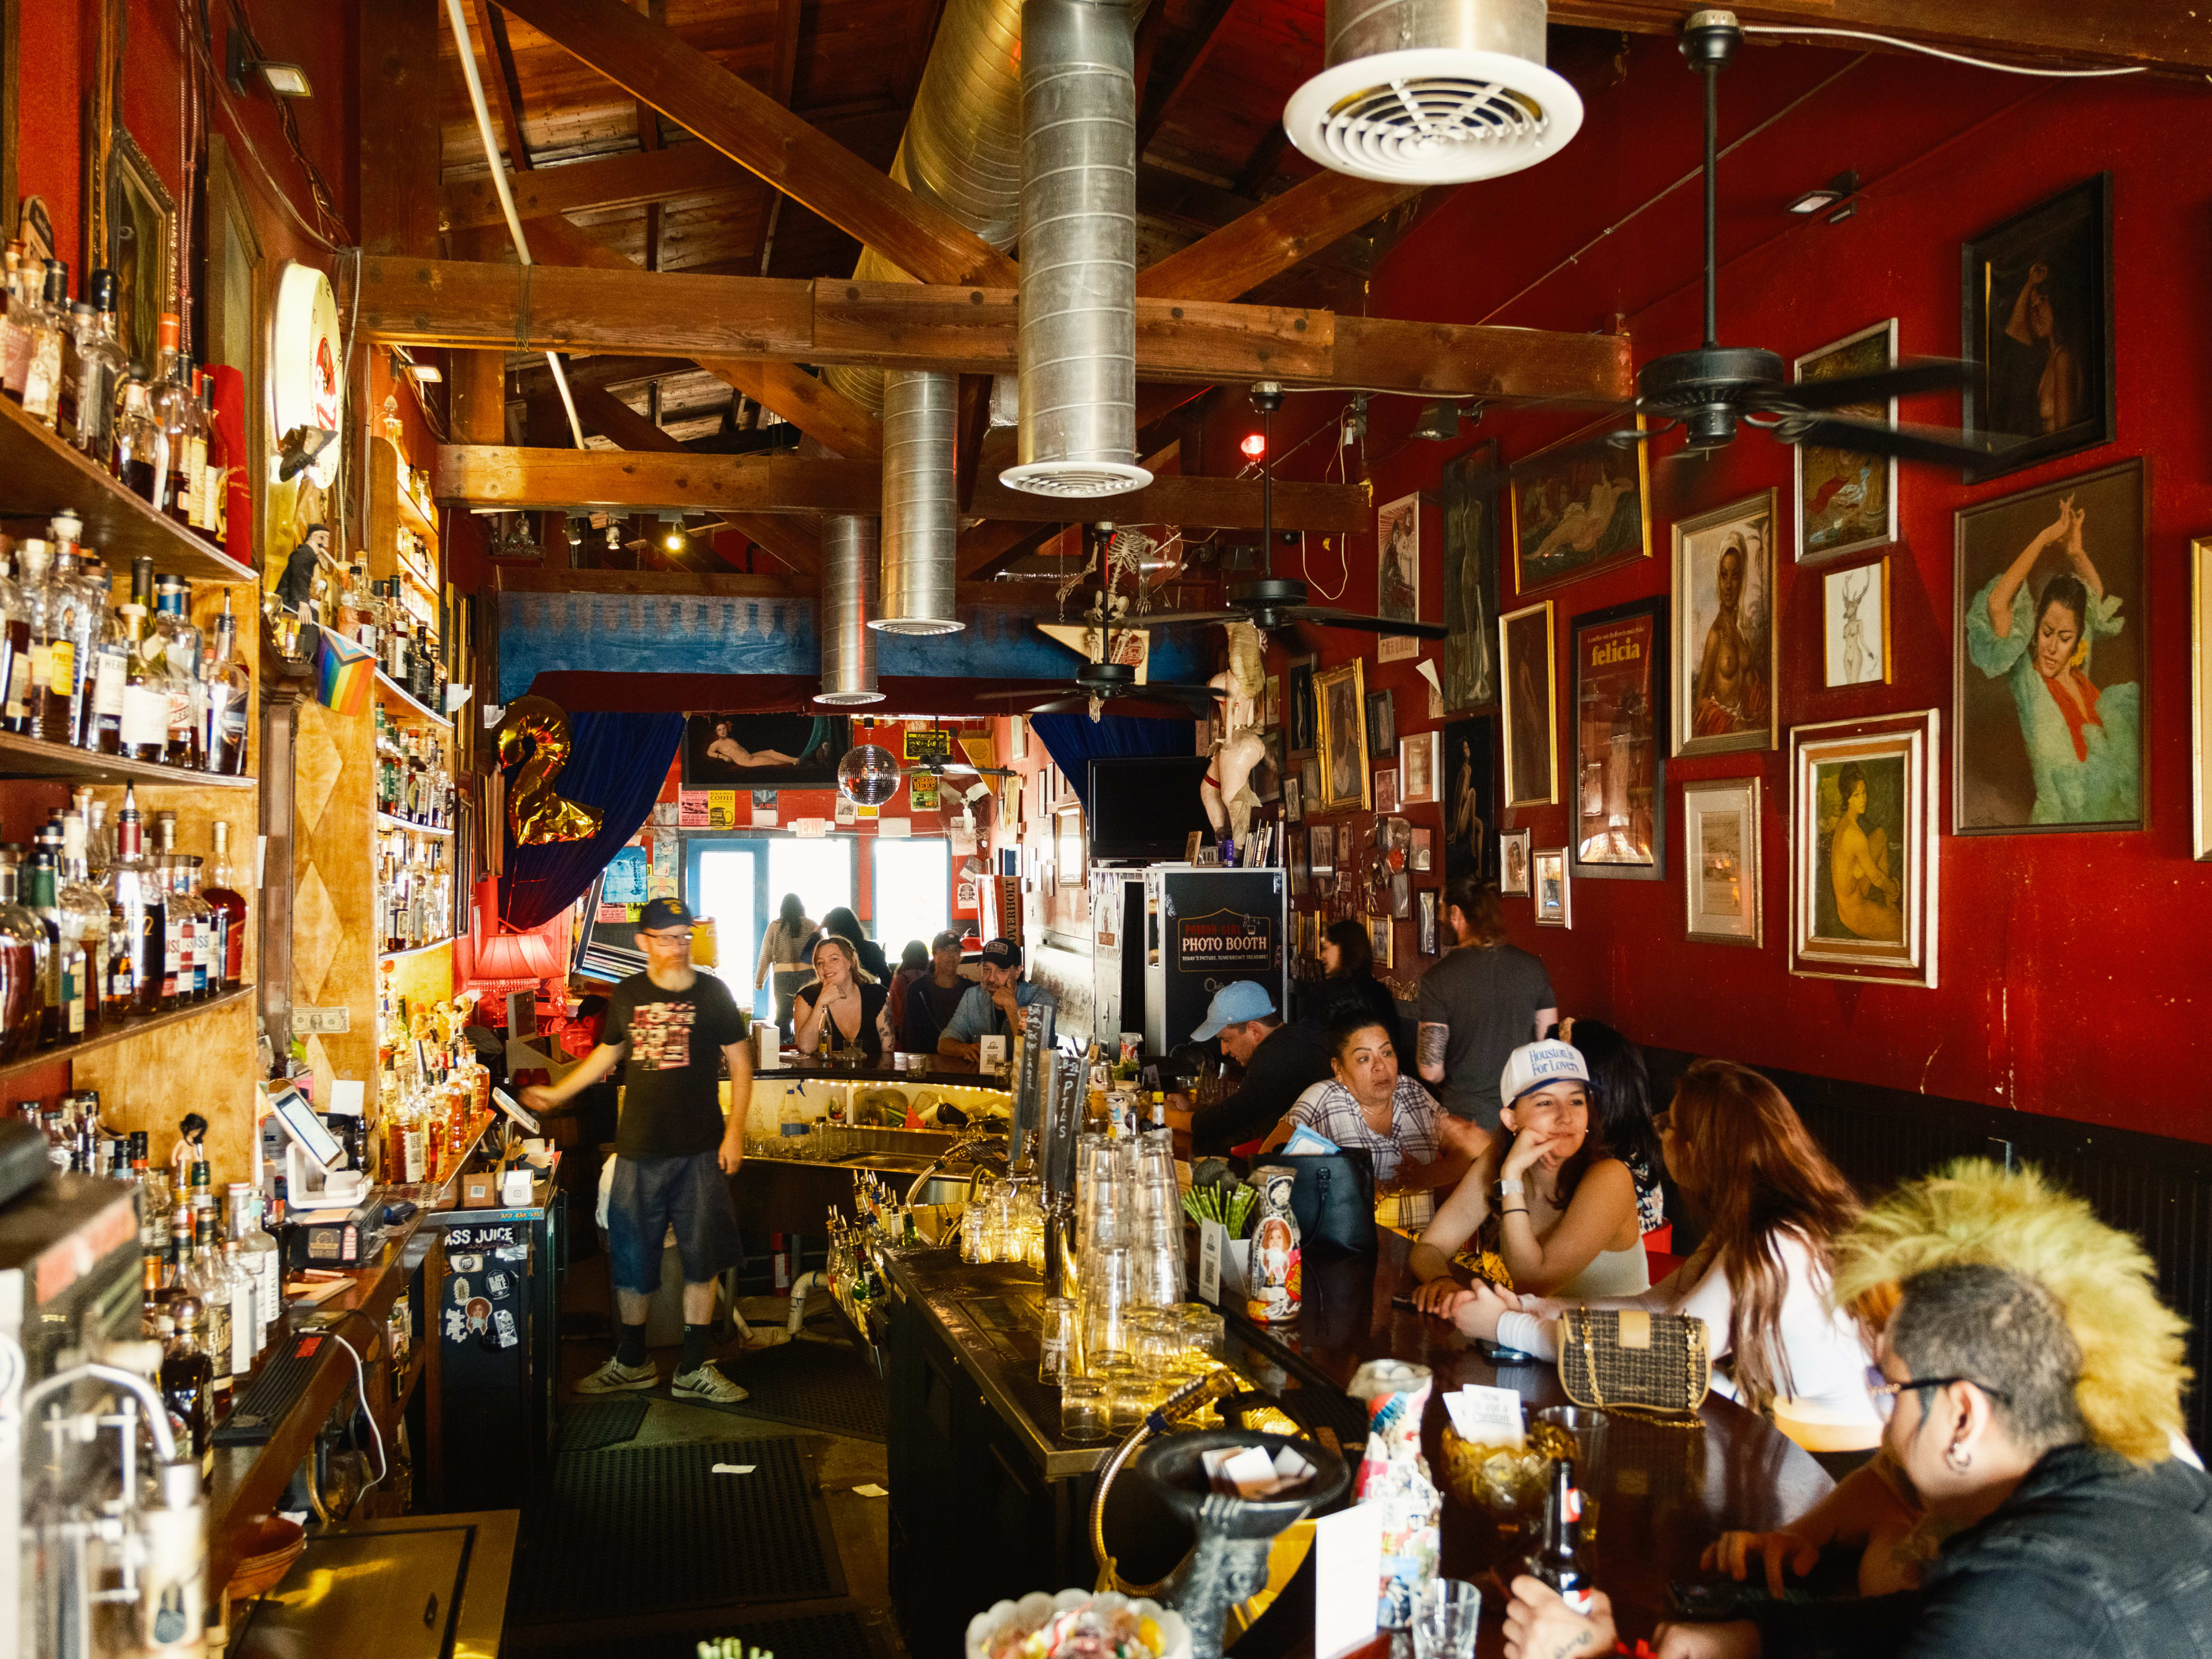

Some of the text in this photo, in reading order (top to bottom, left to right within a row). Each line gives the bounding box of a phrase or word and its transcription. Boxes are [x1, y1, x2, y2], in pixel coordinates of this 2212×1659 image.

[1592, 637, 1641, 666] felicia
[801, 819, 821, 834] EXIT
[1006, 880, 1016, 942] OVERHOLT
[1185, 923, 1241, 935] POISON GIRL
[1182, 935, 1267, 952] PHOTO BOOTH
[1529, 1047, 1575, 1063] Houston's
[1532, 1062, 1548, 1076] For
[1059, 1080, 1074, 1139] PILS
[445, 1227, 513, 1246] ASS JUICE
[488, 1273, 505, 1285] BLACK
[490, 1281, 507, 1293] HOLE
